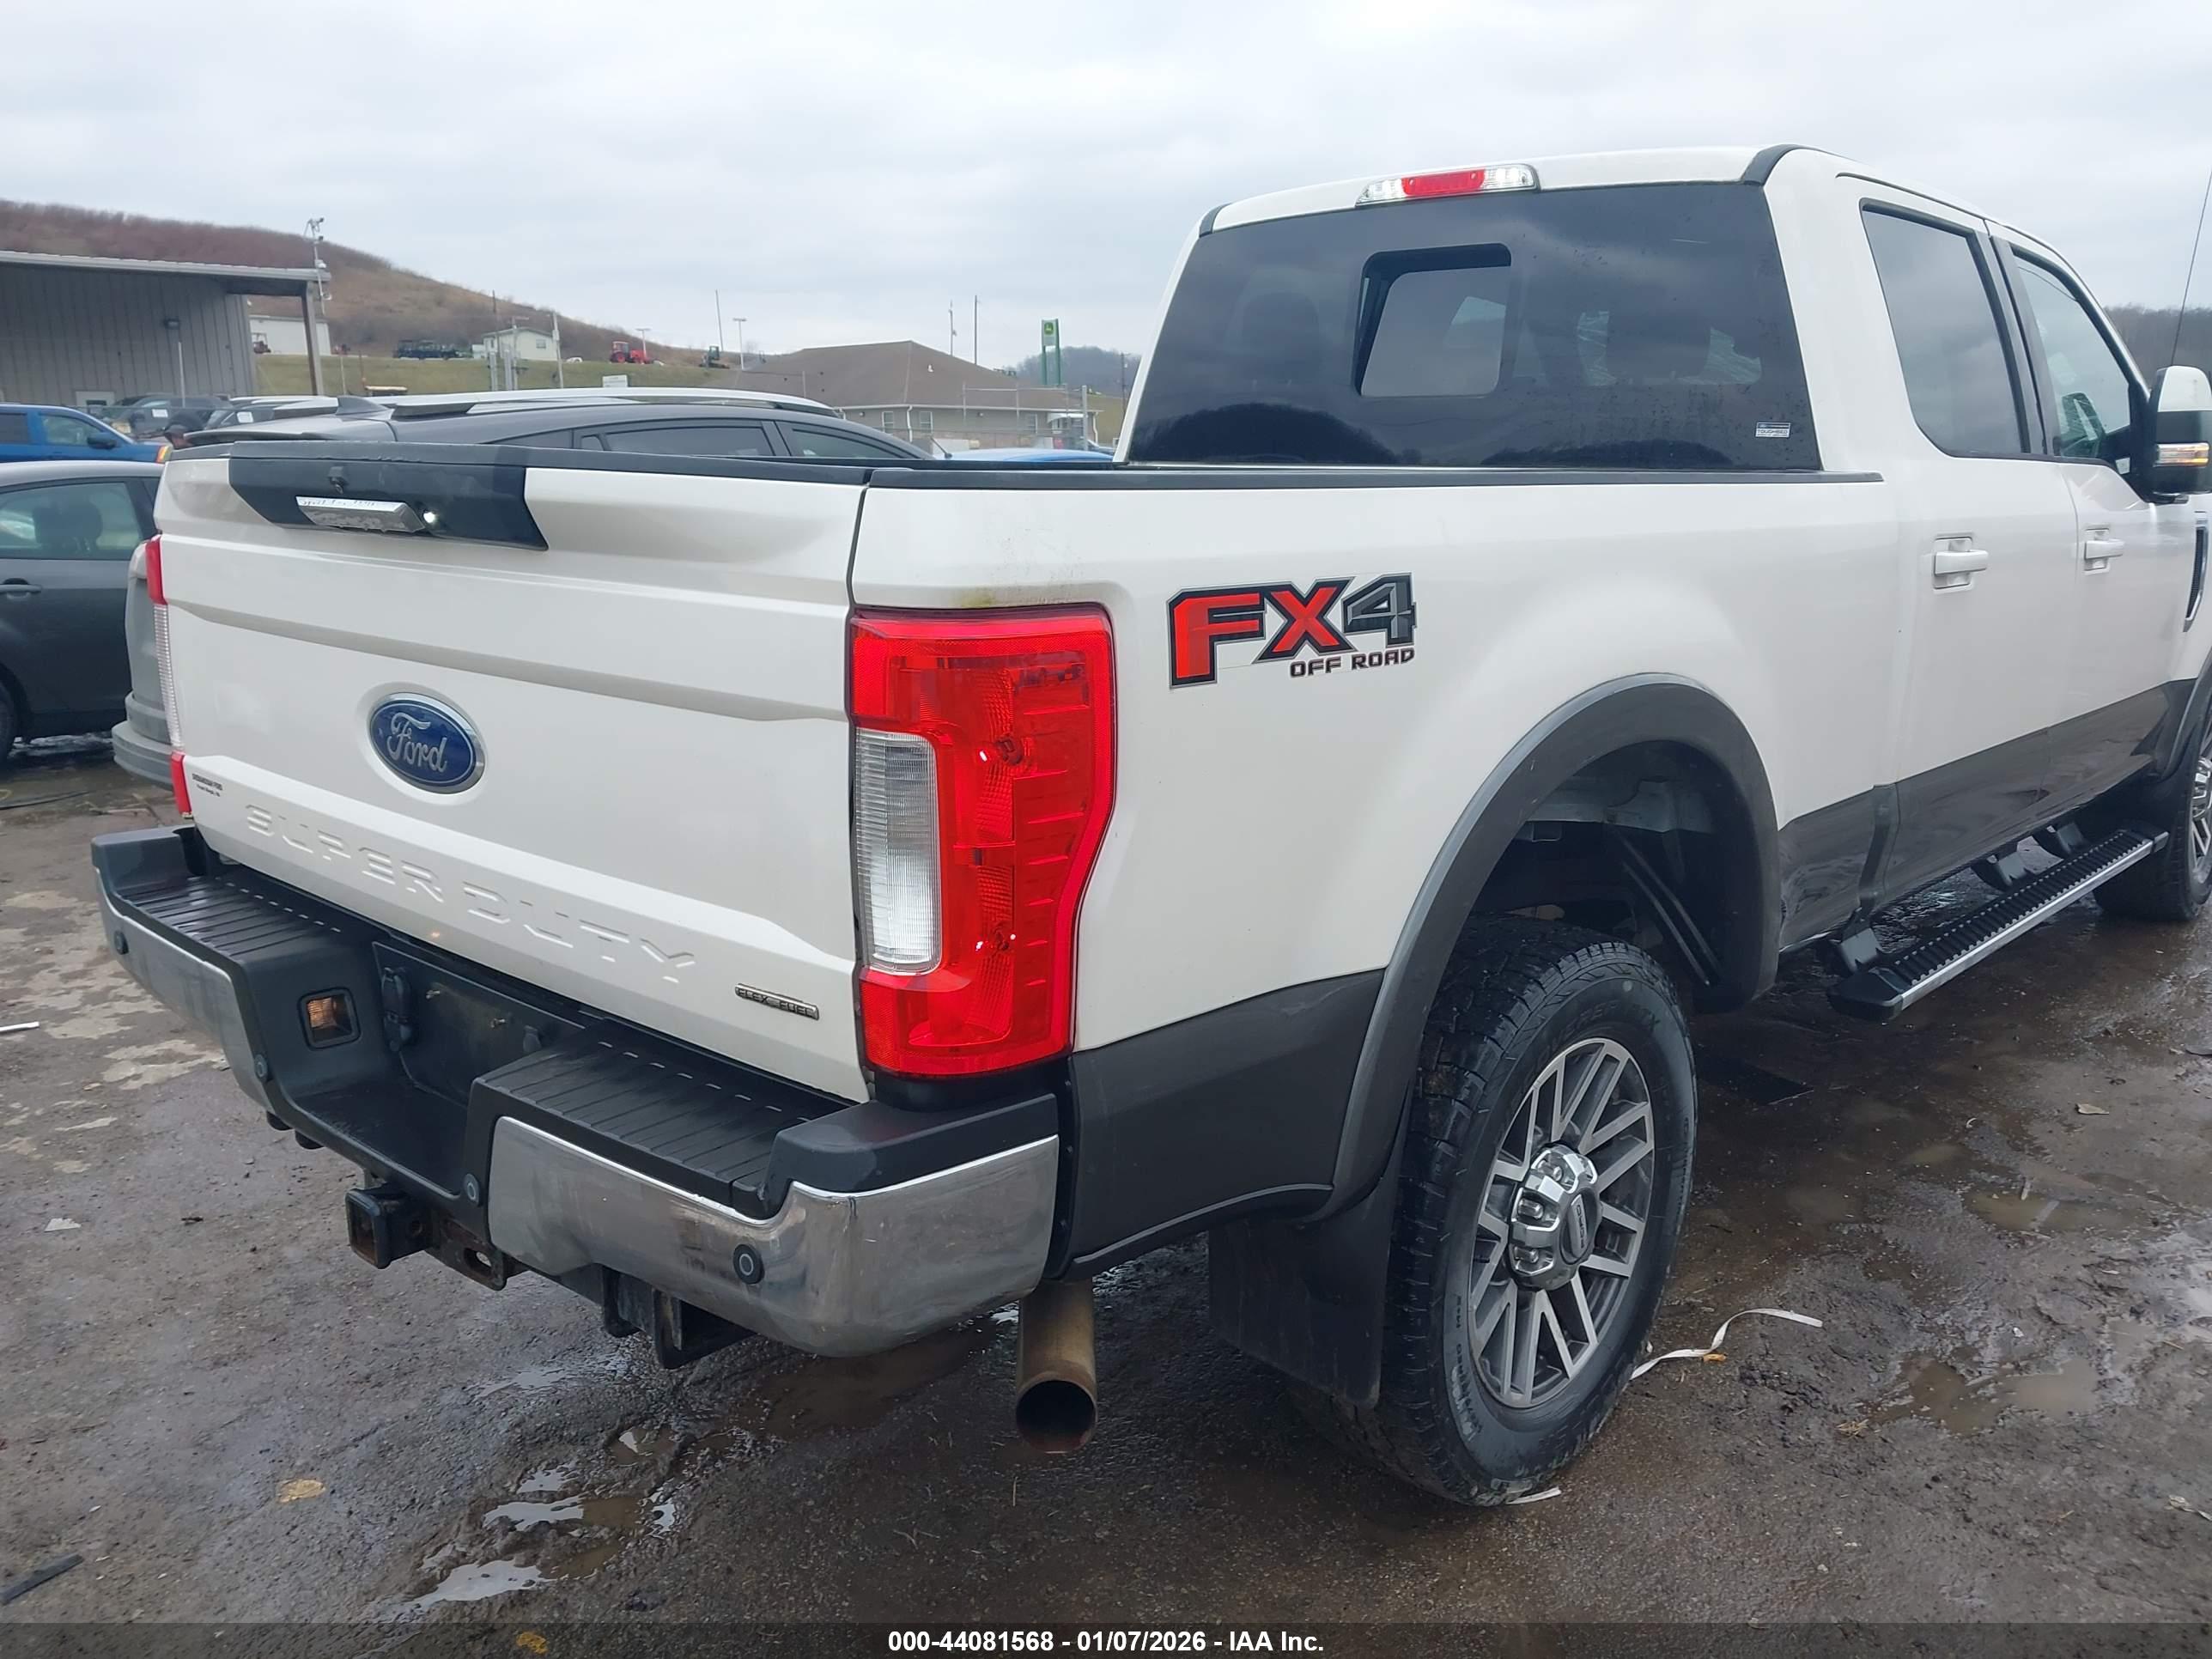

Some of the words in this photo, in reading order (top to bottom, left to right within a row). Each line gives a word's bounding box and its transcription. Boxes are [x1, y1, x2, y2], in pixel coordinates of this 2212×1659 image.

[1167, 573, 1416, 689] FX4
[1290, 655, 1342, 678] OFF
[1351, 647, 1415, 671] ROAD
[387, 712, 447, 773] Ford
[246, 804, 444, 903] SUPER
[463, 881, 696, 984] DUTY
[738, 987, 769, 1005] FLEX
[779, 999, 815, 1018] FUEL
